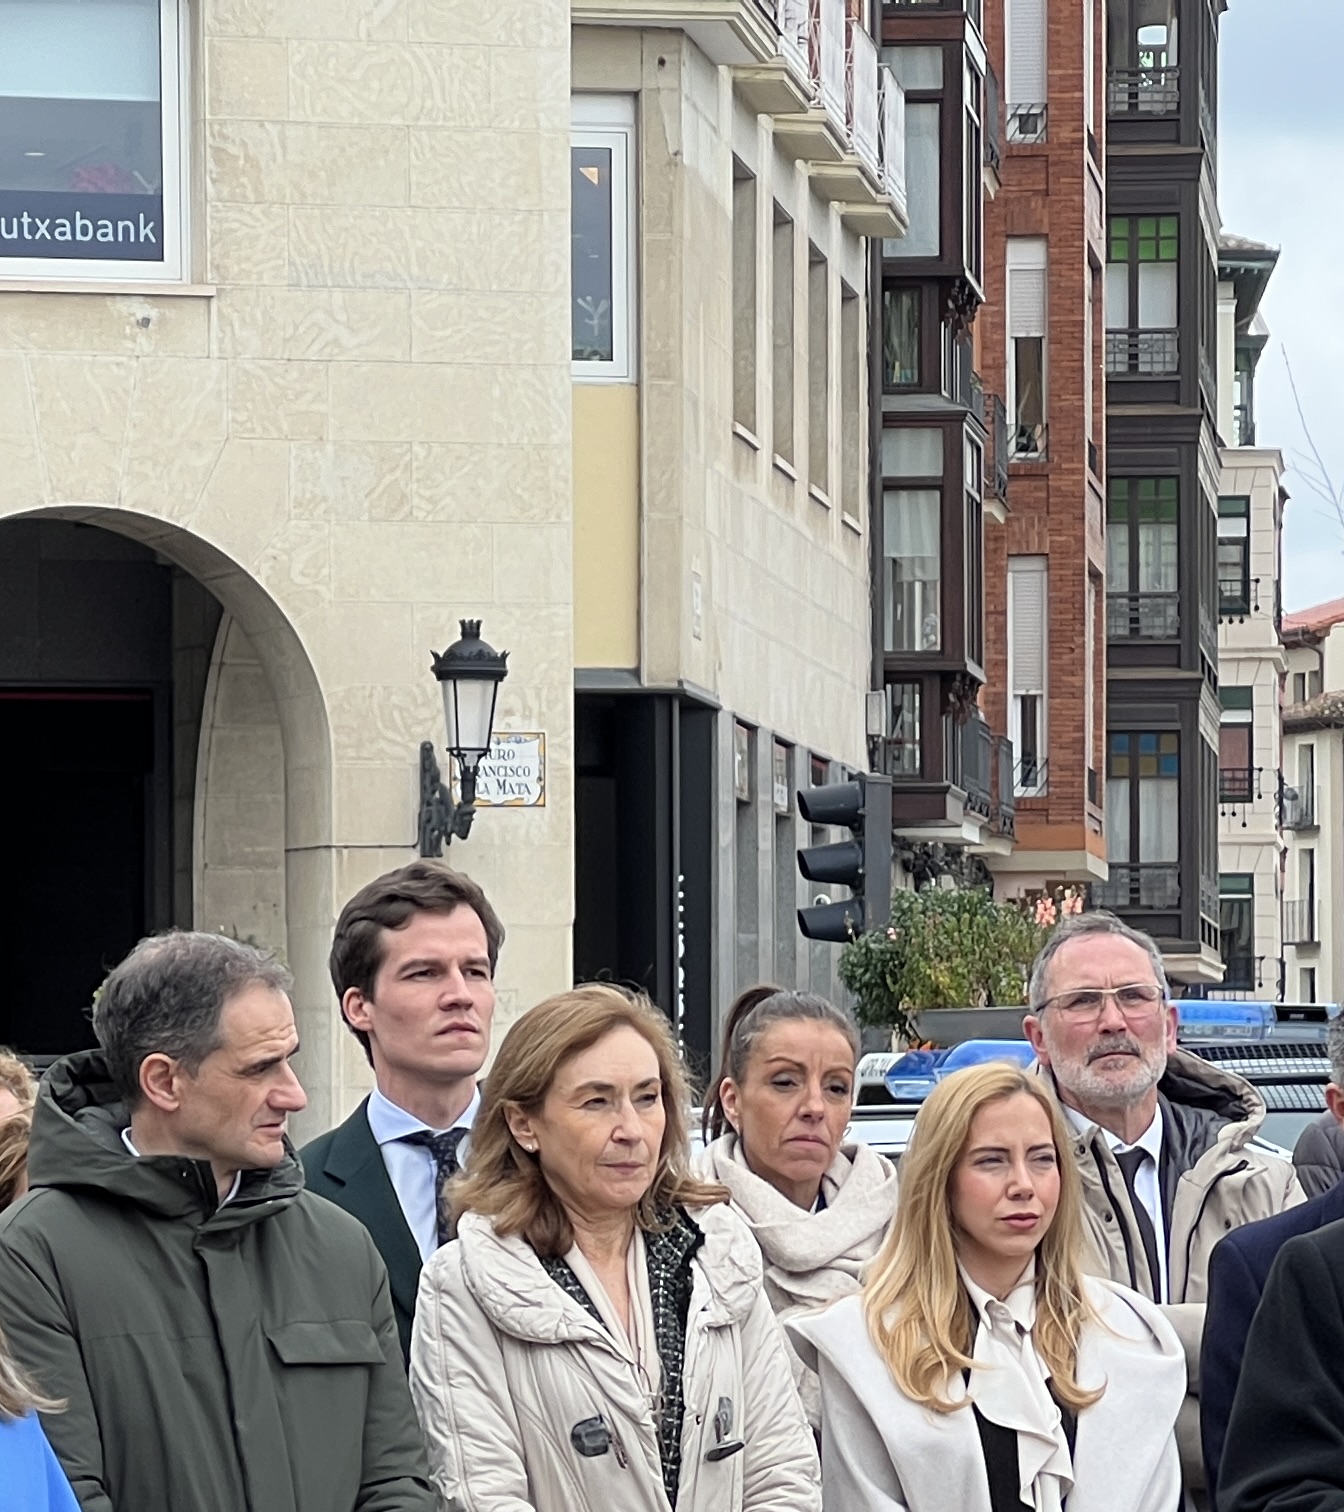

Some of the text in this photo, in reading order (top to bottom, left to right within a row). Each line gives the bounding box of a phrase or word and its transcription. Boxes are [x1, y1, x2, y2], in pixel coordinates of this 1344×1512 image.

[485, 748, 516, 761] URO
[477, 765, 531, 778] ANCISCO
[476, 778, 532, 795] LA MATA
